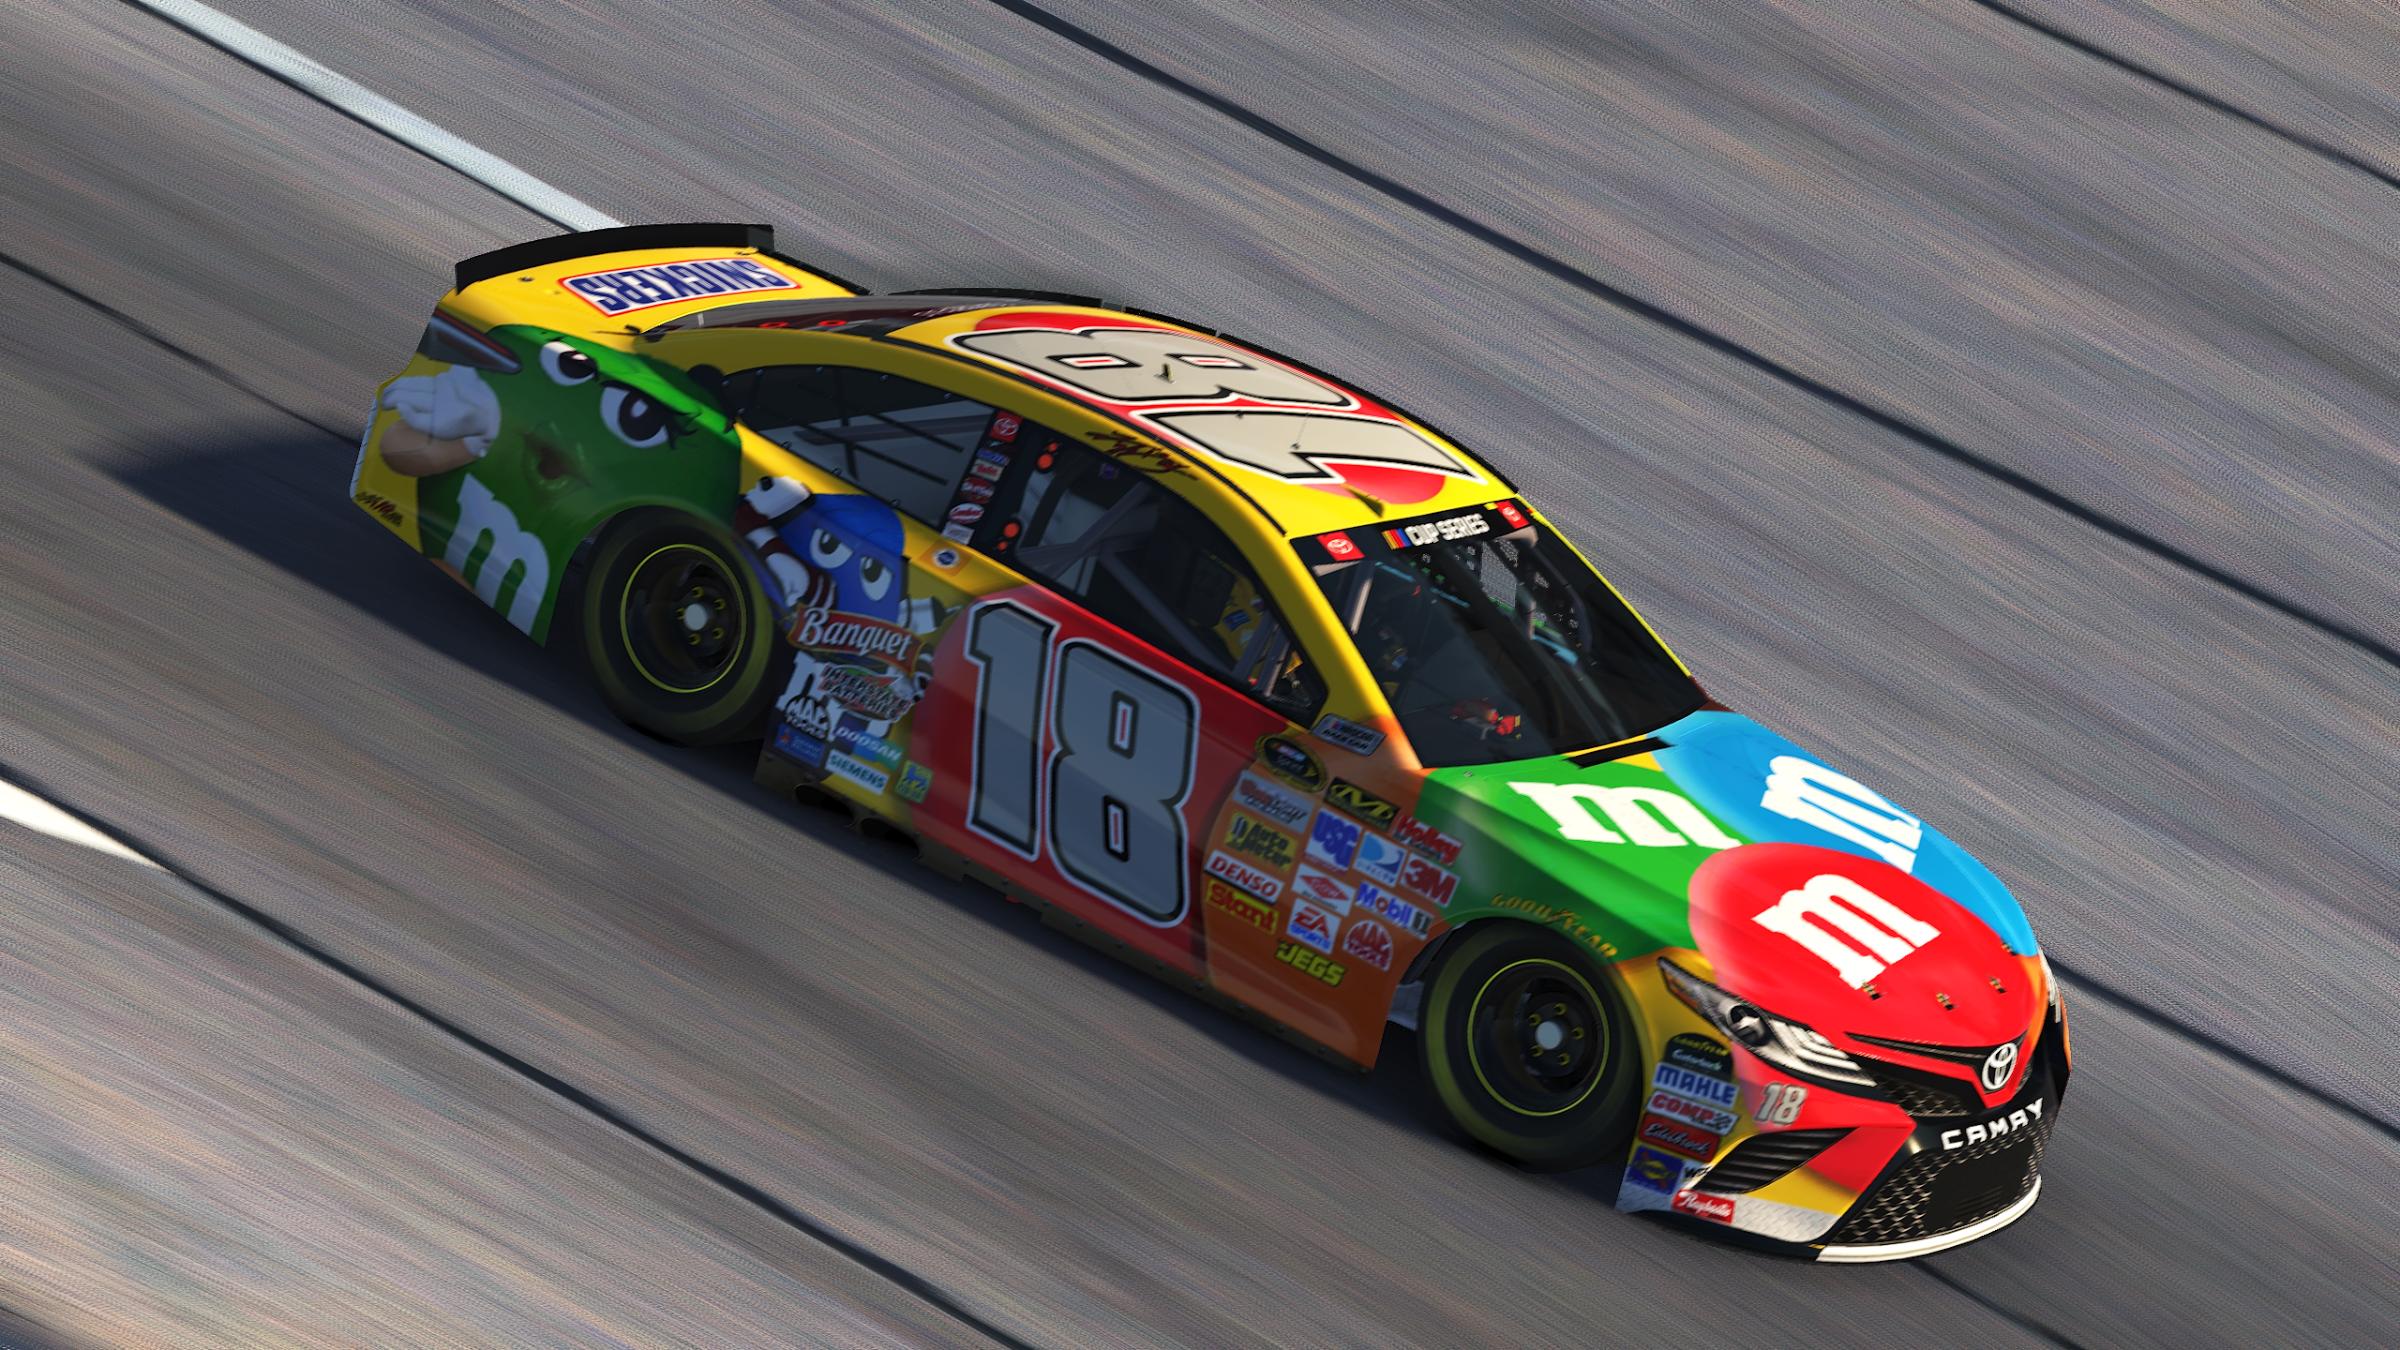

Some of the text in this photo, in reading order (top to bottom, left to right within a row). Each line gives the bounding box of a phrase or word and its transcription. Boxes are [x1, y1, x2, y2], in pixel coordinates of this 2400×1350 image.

[570, 260, 791, 311] SNICKERS
[1405, 512, 1490, 547] CUP SERIES
[799, 607, 914, 661] Banquet
[835, 725, 904, 762] DOOSAN
[963, 597, 1200, 929] 18
[830, 753, 889, 790] SIEMENS
[1506, 780, 1743, 849] m
[1759, 756, 1923, 873] m
[1210, 855, 1278, 898] DENSO
[1405, 858, 1457, 906] 3M
[1295, 906, 1330, 938] EA
[1356, 882, 1413, 929] Mobil
[1751, 874, 1941, 990] m
[1275, 941, 1347, 987] JEGS
[1651, 1093, 1714, 1122] COMP
[1655, 1066, 1738, 1105] MAHLE
[1755, 1082, 1806, 1126] 18
